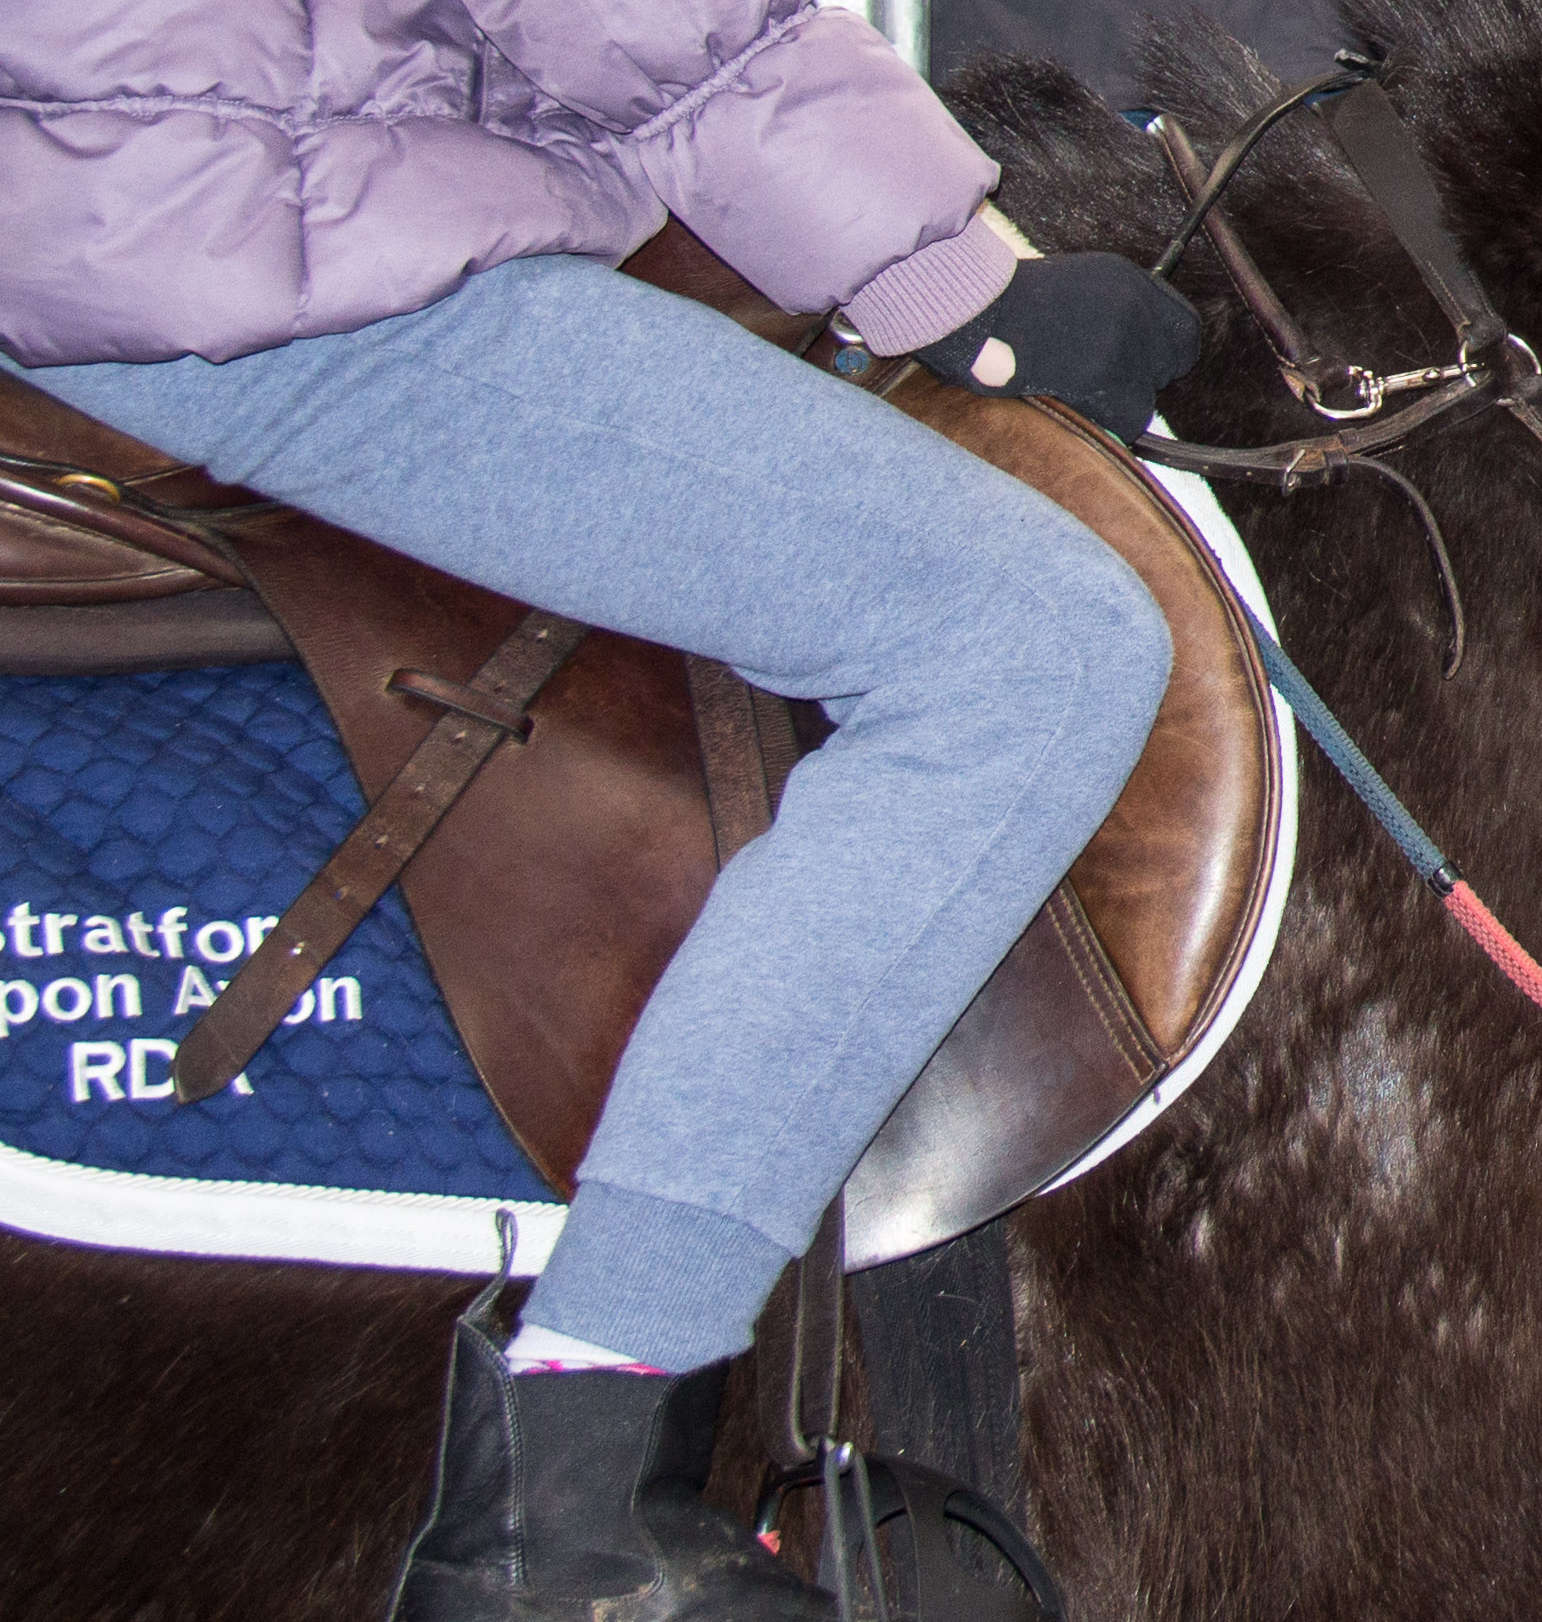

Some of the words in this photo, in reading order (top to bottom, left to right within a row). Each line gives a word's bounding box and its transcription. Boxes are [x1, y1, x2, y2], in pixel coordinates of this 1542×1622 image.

[0, 900, 280, 963] tratfor
[0, 972, 143, 1039] pon
[173, 964, 363, 1026] An
[71, 1038, 255, 1102] RD
